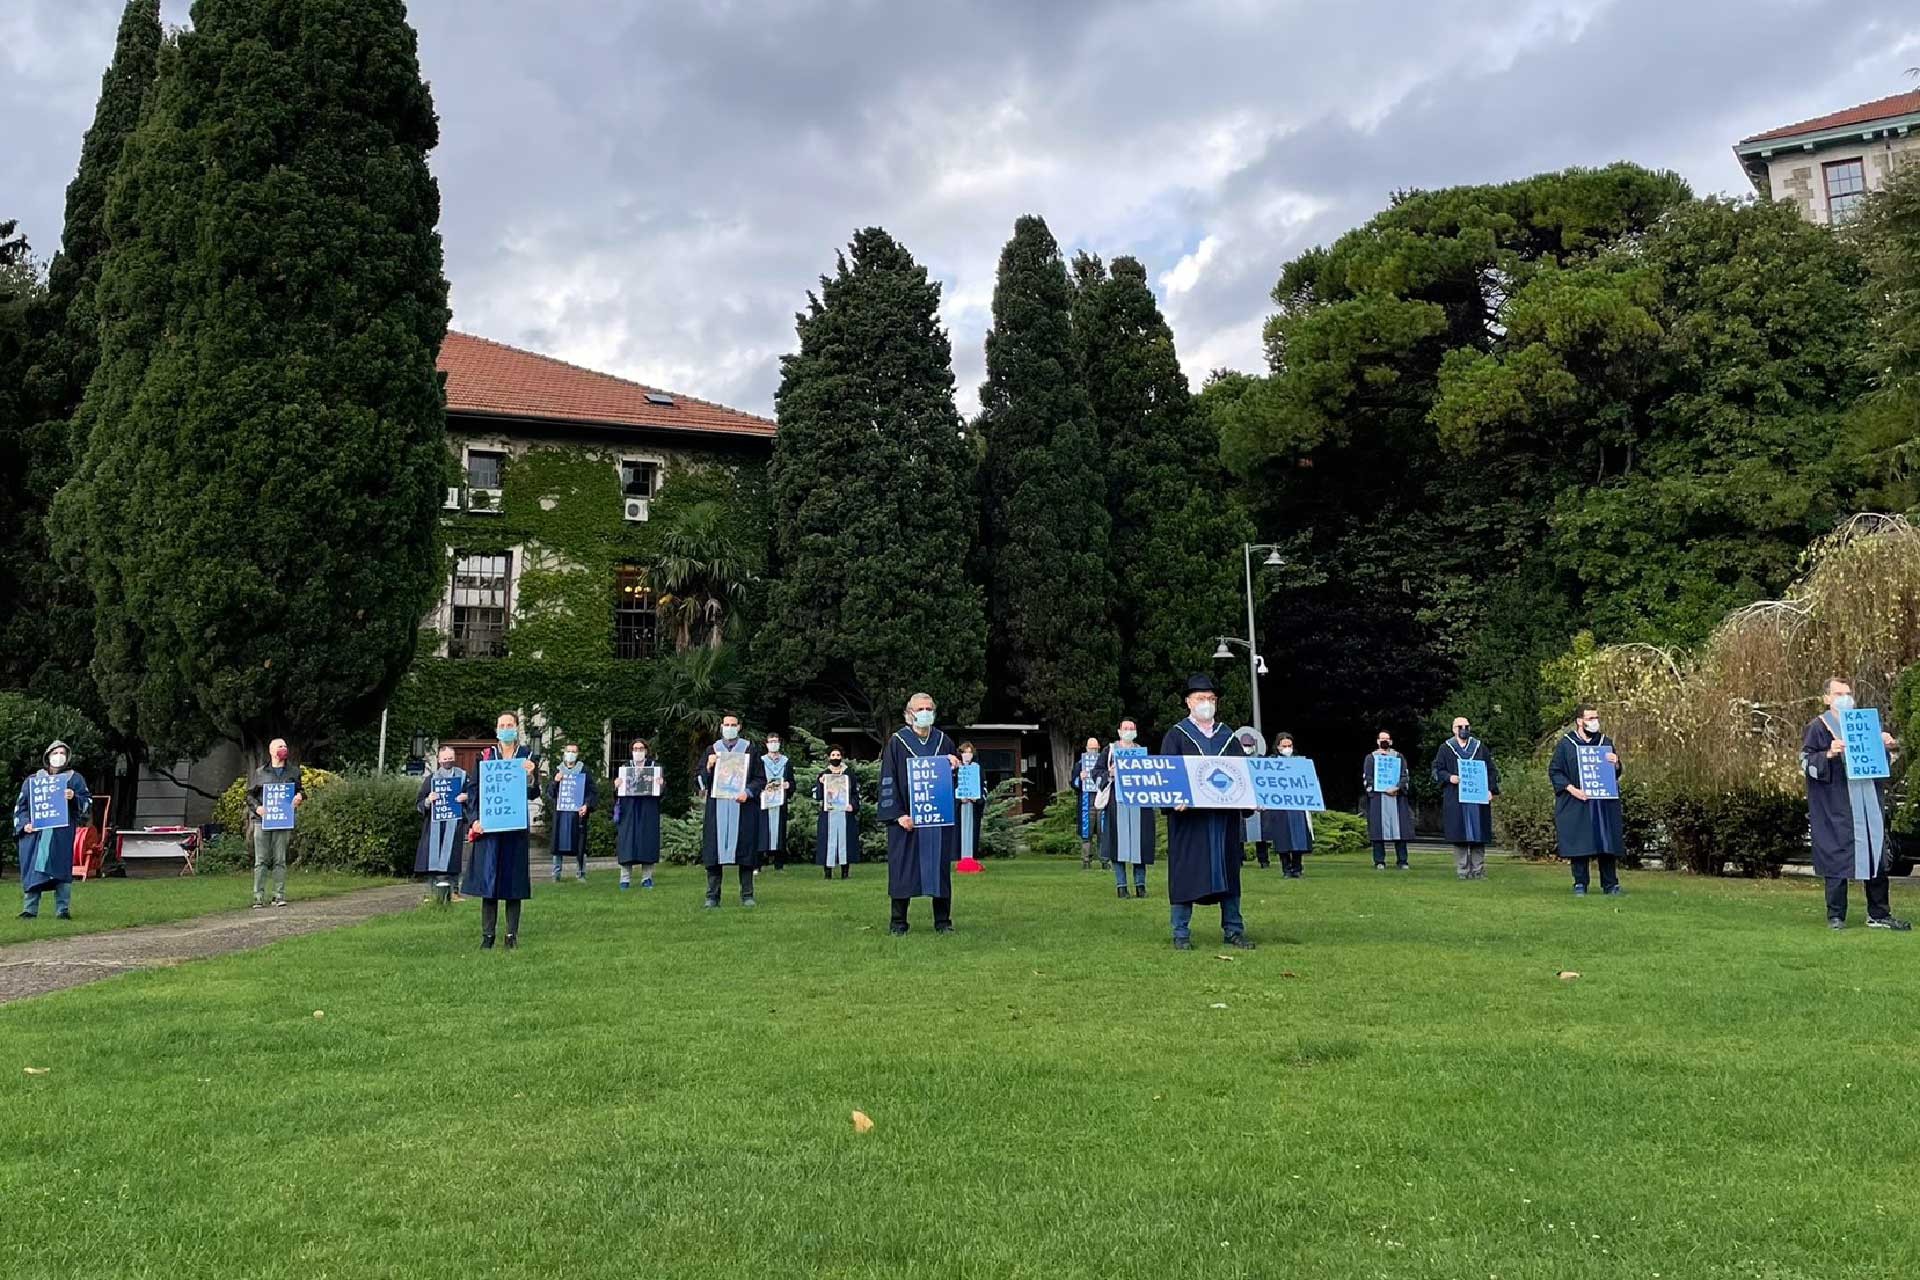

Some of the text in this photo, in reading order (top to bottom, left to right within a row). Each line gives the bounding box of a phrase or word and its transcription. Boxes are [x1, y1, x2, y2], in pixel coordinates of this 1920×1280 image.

[1845, 711, 1868, 721] KA-
[1847, 722, 1870, 731] BUL
[1848, 733, 1868, 741] ET-
[912, 759, 935, 768] KA-
[1117, 758, 1176, 769] KABUL
[1852, 755, 1873, 763] YO-
[485, 761, 517, 771] VAZ-
[1250, 759, 1291, 771] VAZ-
[913, 769, 938, 778] BUL
[1854, 766, 1882, 774] RUZ.
[34, 776, 60, 785] VAZ-
[485, 773, 517, 784] GEÇ-
[1121, 772, 1169, 786] ETMİ-
[1255, 775, 1315, 790] GEÇMİ-
[914, 781, 934, 790] ET-
[1584, 780, 1604, 788] YO-
[486, 796, 509, 805] YO-
[1123, 791, 1189, 804] YORUZ.
[1259, 794, 1321, 807] YORUZ.
[35, 802, 54, 811] YO-
[485, 806, 517, 816] RUZ.
[915, 803, 937, 813] YO-
[35, 810, 60, 819] RUZ.
[915, 813, 944, 824] RUZ.
